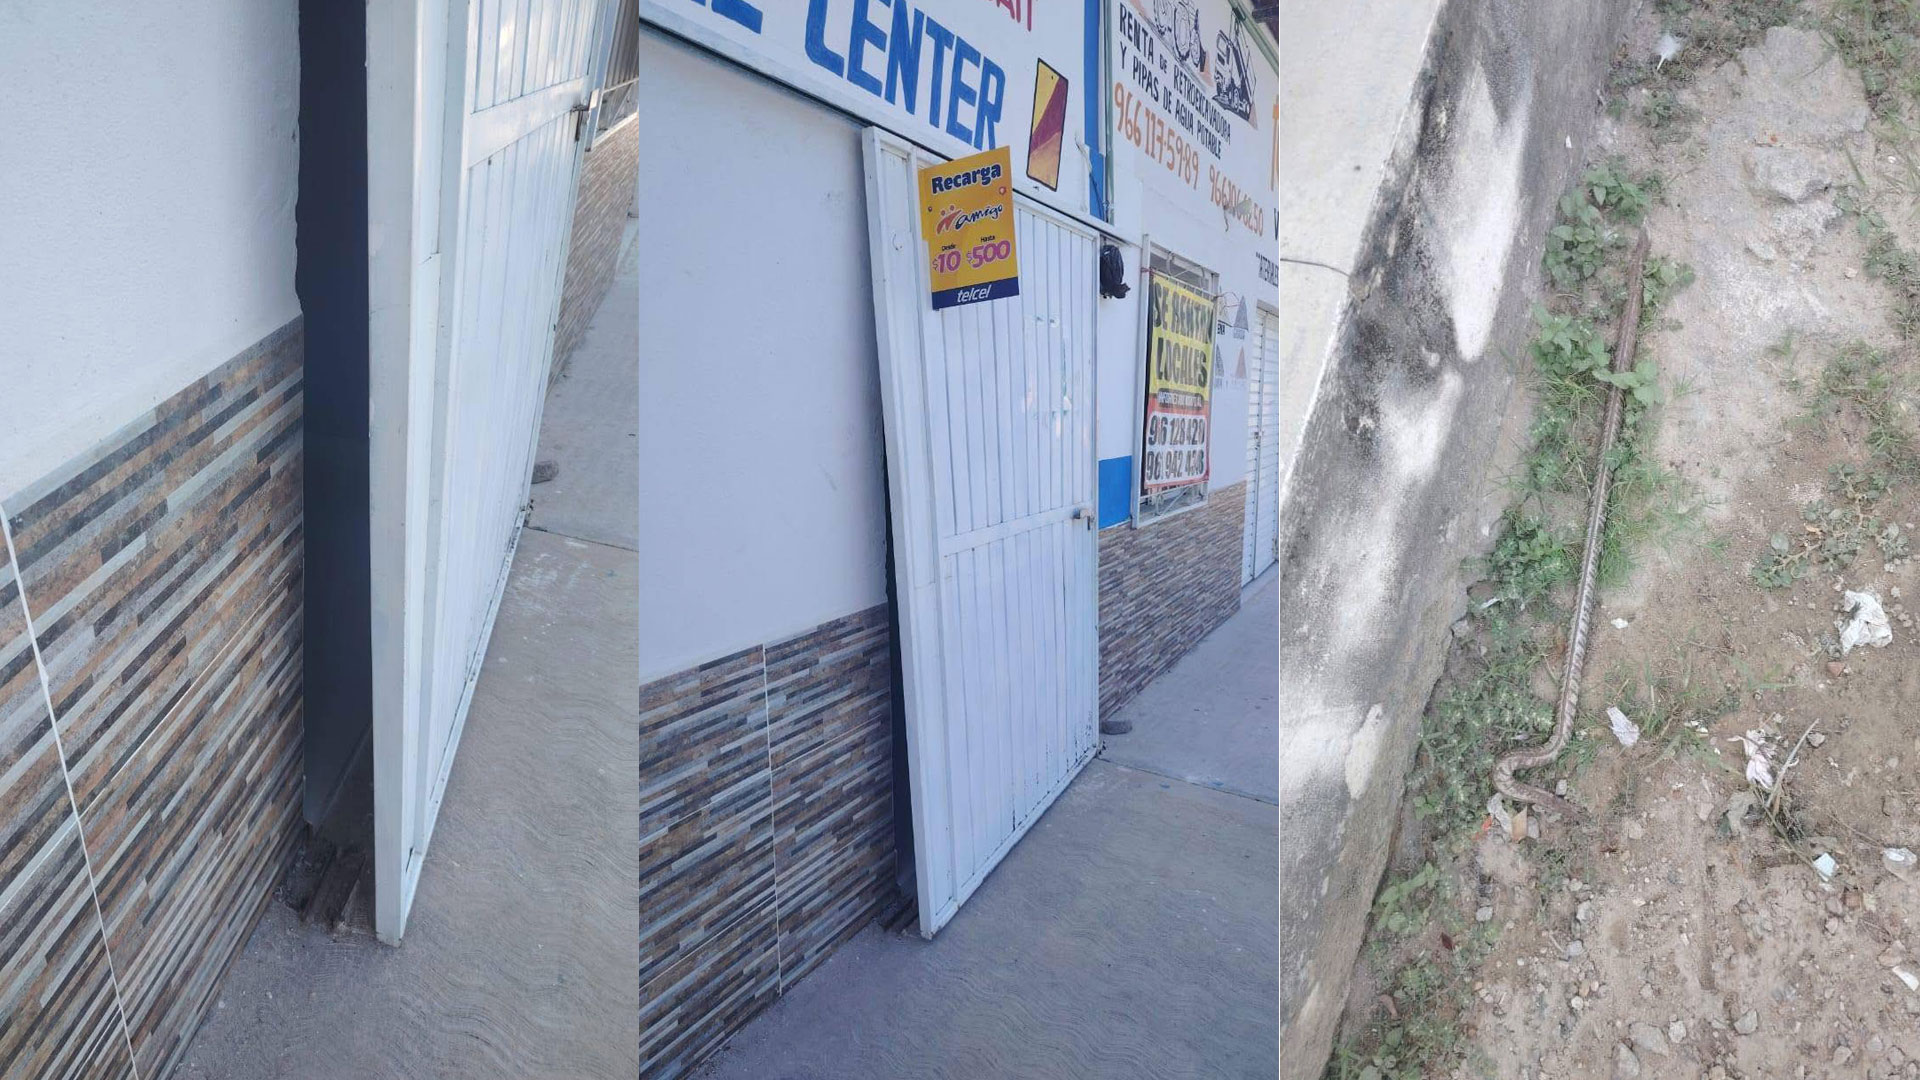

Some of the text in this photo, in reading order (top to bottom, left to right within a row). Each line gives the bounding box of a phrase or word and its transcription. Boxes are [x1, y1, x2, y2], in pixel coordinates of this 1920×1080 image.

[1119, 3, 1154, 65] RENTA
[1159, 53, 1168, 75] DE
[804, 0, 1006, 151] CENTER
[1114, 81, 1142, 148] 966
[1119, 41, 1222, 161] Y PIPAS DE AGUA POTABLE
[931, 163, 1002, 195] Recarga
[955, 203, 1004, 231] amigo
[980, 234, 996, 243] Hasta
[932, 239, 1011, 273] $10 $500
[957, 284, 992, 303] telcel
